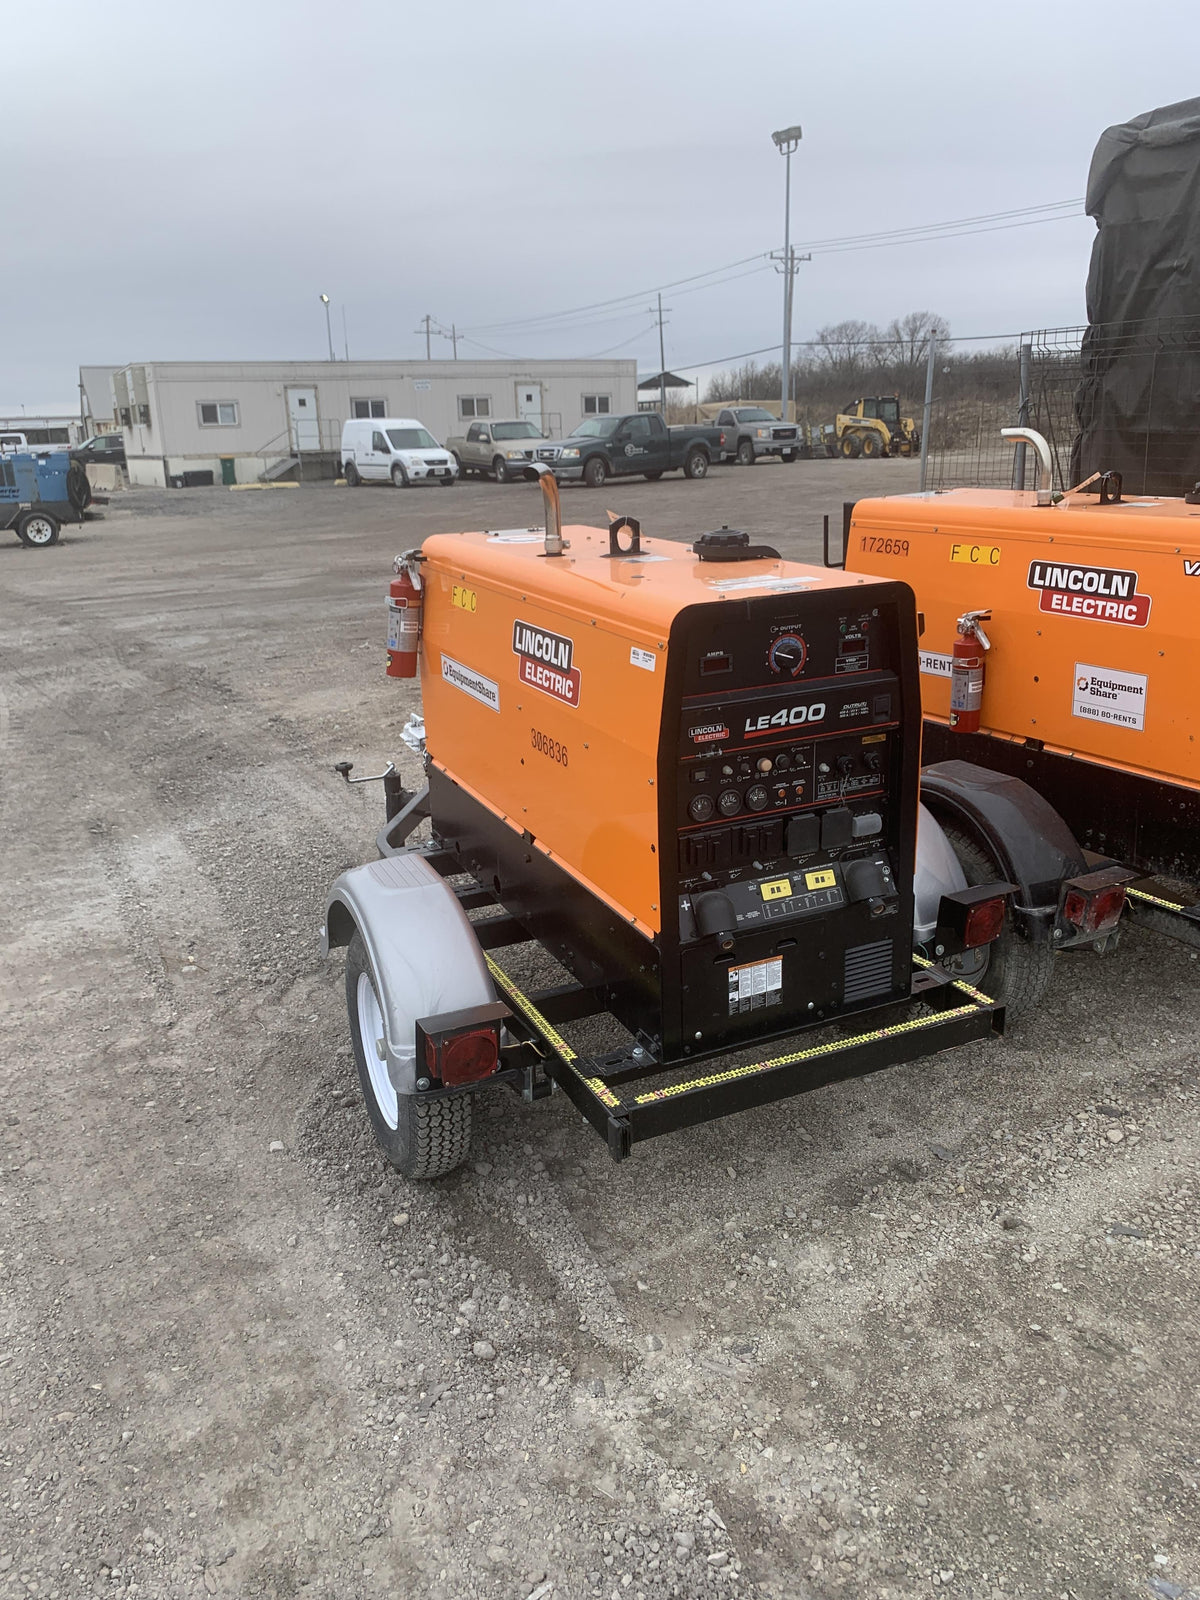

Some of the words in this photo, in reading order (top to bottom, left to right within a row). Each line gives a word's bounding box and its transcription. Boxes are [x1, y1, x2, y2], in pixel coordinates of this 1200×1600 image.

[861, 536, 910, 557] 172659
[1033, 565, 1130, 597] LINCOLN
[1050, 594, 1138, 621] ELECTRIC
[515, 626, 570, 669] LINCOLN
[448, 664, 497, 702] EquipmentShare
[525, 661, 574, 699] ELECTRIC
[1090, 676, 1144, 695] Equipment
[1090, 686, 1118, 700] Share
[744, 703, 826, 731] LE400
[1079, 705, 1099, 716] (888)
[1101, 710, 1137, 724] 80-RENTS
[690, 725, 722, 736] LINCOLN
[698, 731, 726, 741] ELECTRIC
[531, 728, 568, 767] 306836
